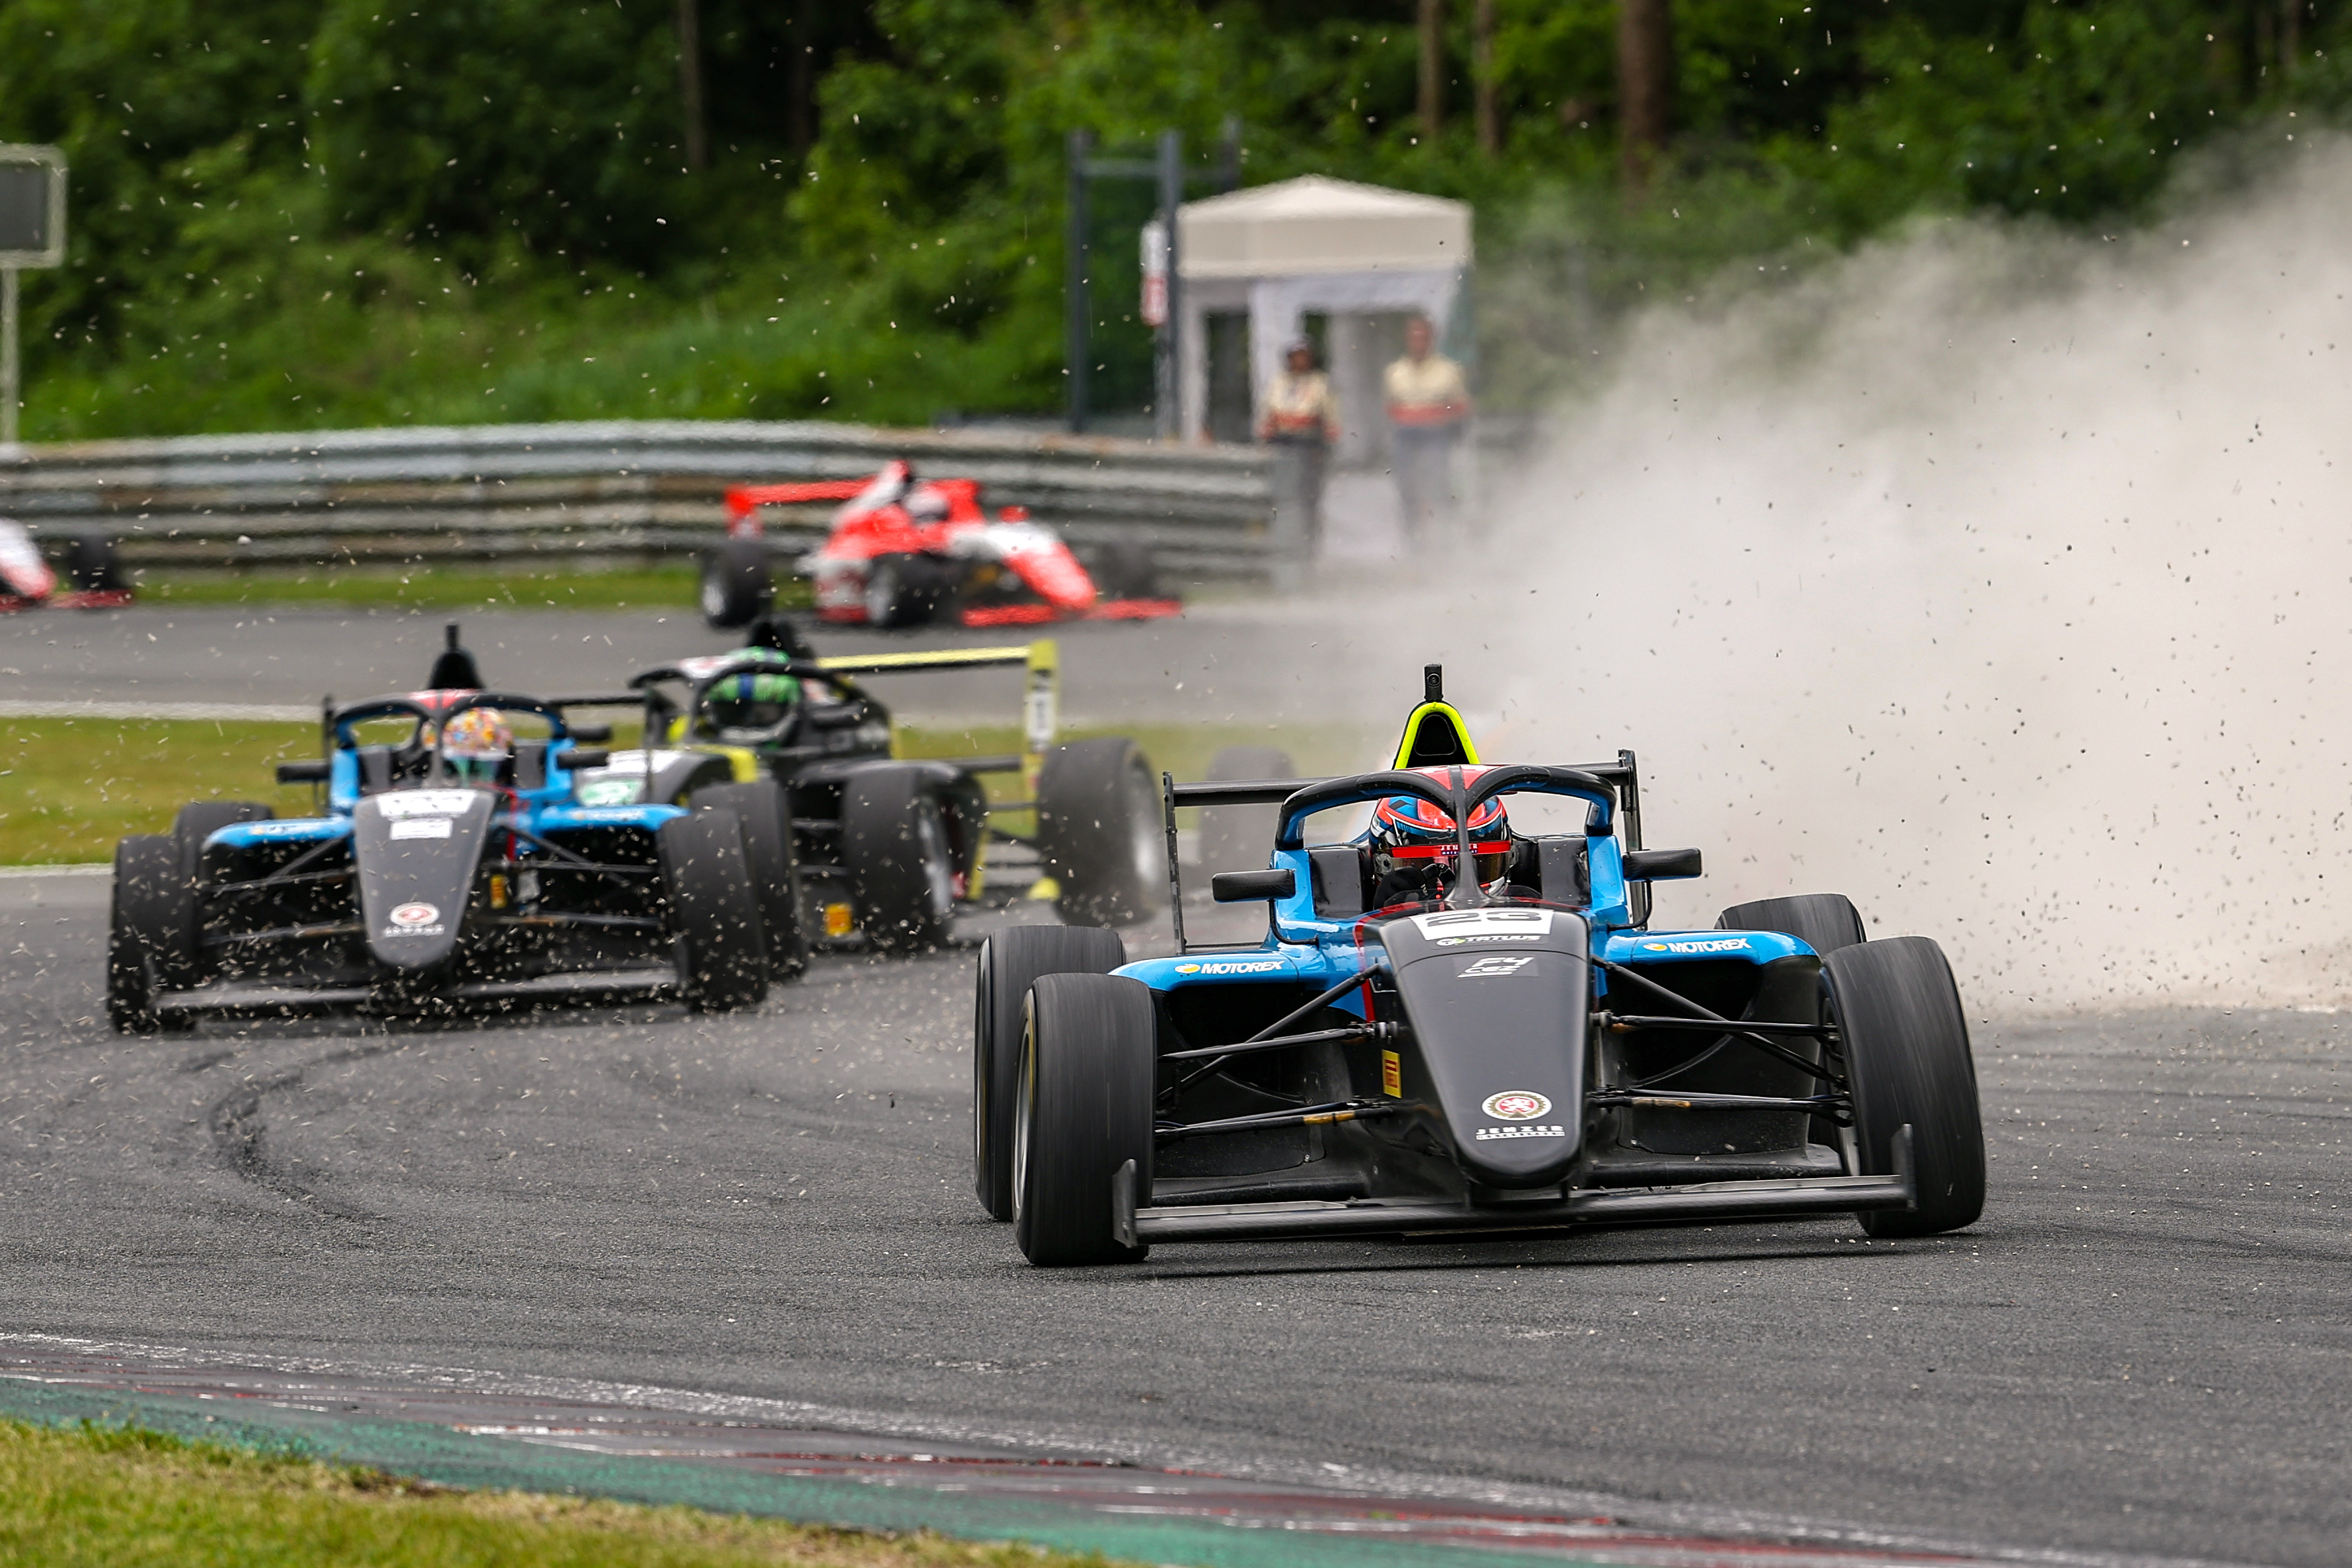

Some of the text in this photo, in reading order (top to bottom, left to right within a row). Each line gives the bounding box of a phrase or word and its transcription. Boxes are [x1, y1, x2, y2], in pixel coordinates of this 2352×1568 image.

[1425, 911, 1542, 927] 23
[1666, 938, 1753, 953] MOTOREX
[1200, 961, 1285, 975] MOTOREX
[1470, 957, 1535, 967] F4
